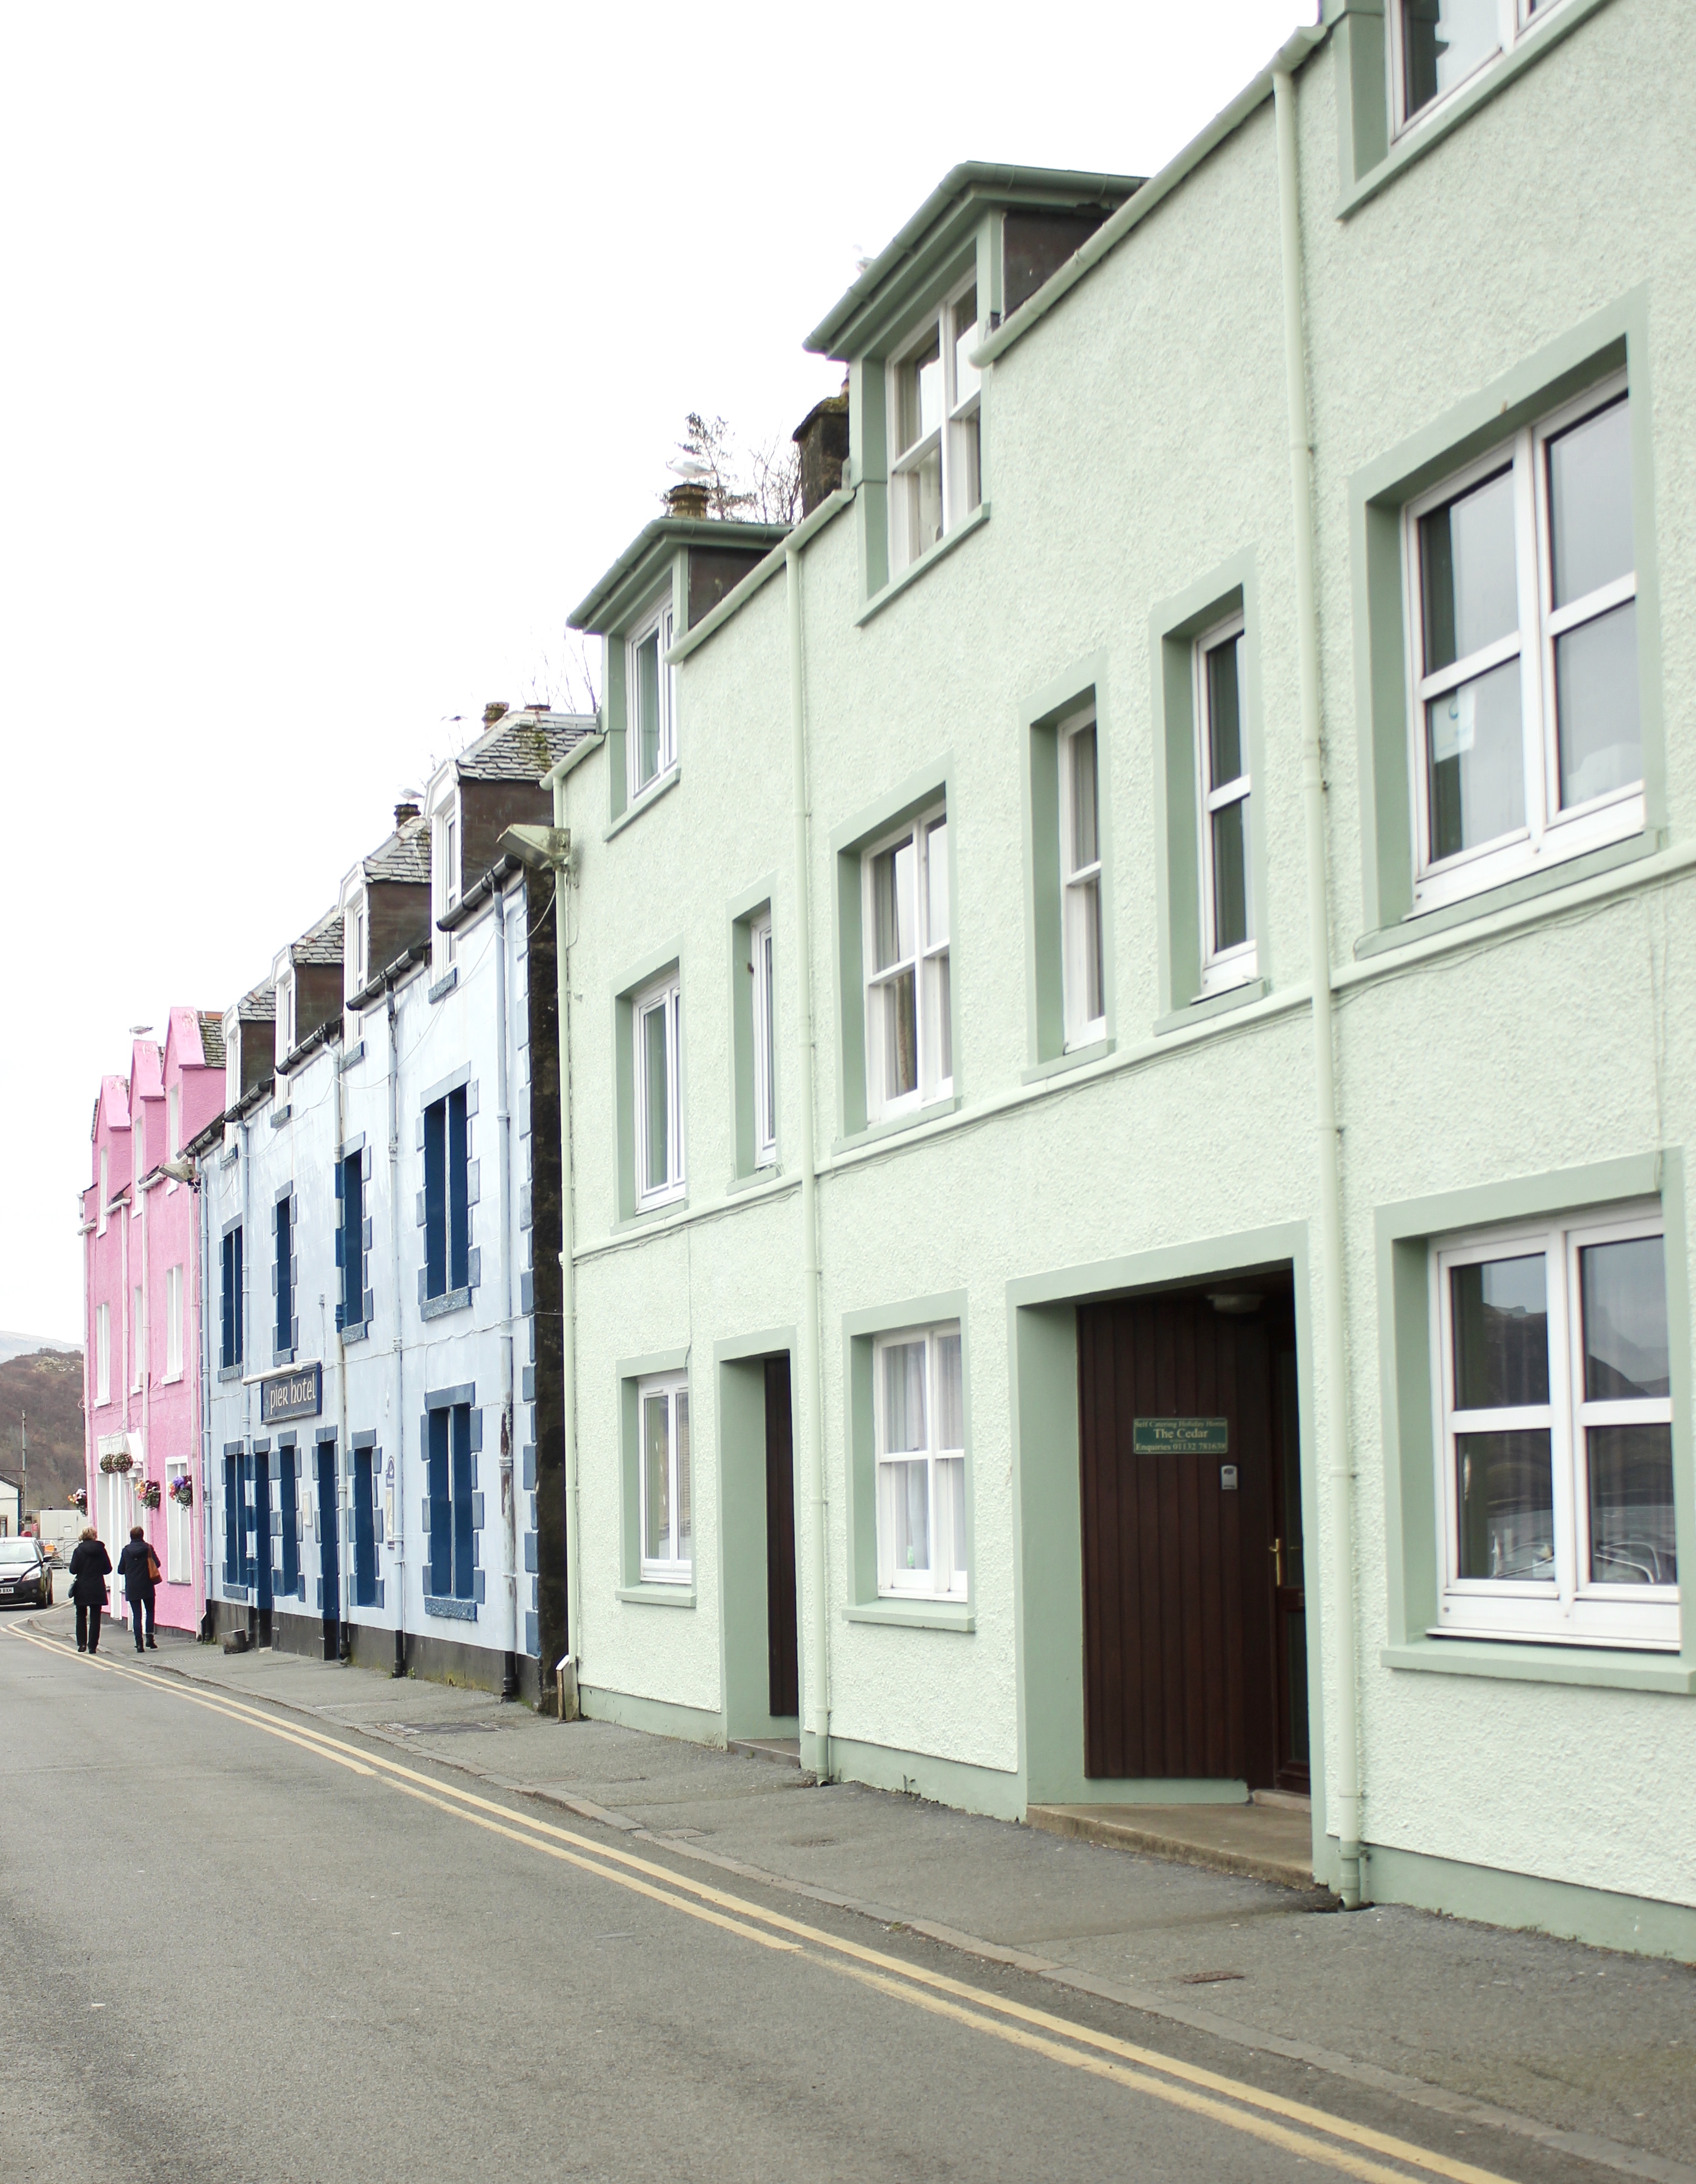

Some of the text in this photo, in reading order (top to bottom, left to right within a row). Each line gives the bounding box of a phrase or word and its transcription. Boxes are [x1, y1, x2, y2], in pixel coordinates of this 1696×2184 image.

[290, 1372, 316, 1404] hotel
[1153, 1428, 1208, 1439] The Cedar
[1135, 1443, 1171, 1453] Enquiries
